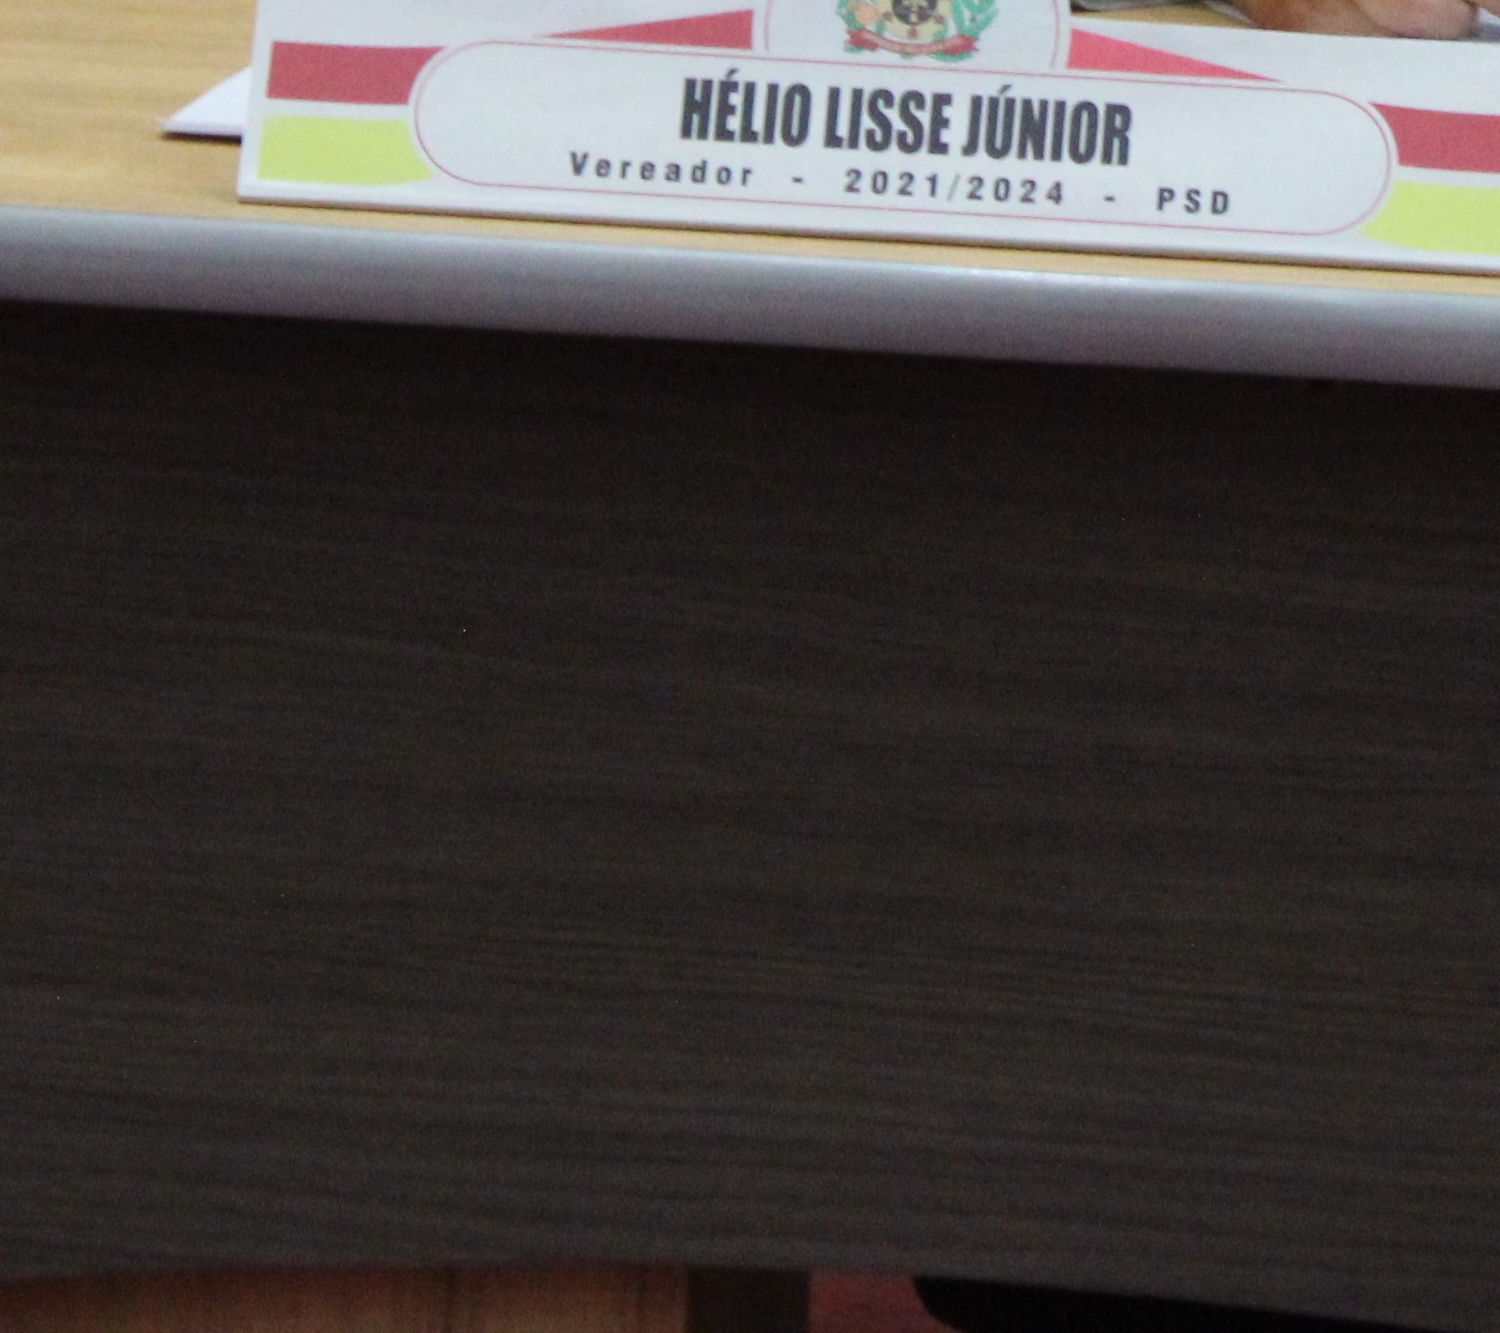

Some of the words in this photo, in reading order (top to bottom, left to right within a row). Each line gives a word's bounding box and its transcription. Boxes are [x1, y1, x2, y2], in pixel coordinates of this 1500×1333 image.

[680, 68, 812, 148] HÉLIO
[823, 86, 953, 156] LISSE
[961, 84, 1133, 166] JÚNIOR
[569, 151, 753, 187] Vereador
[844, 168, 1064, 206] 2021/2024
[1156, 186, 1231, 216] PSD
